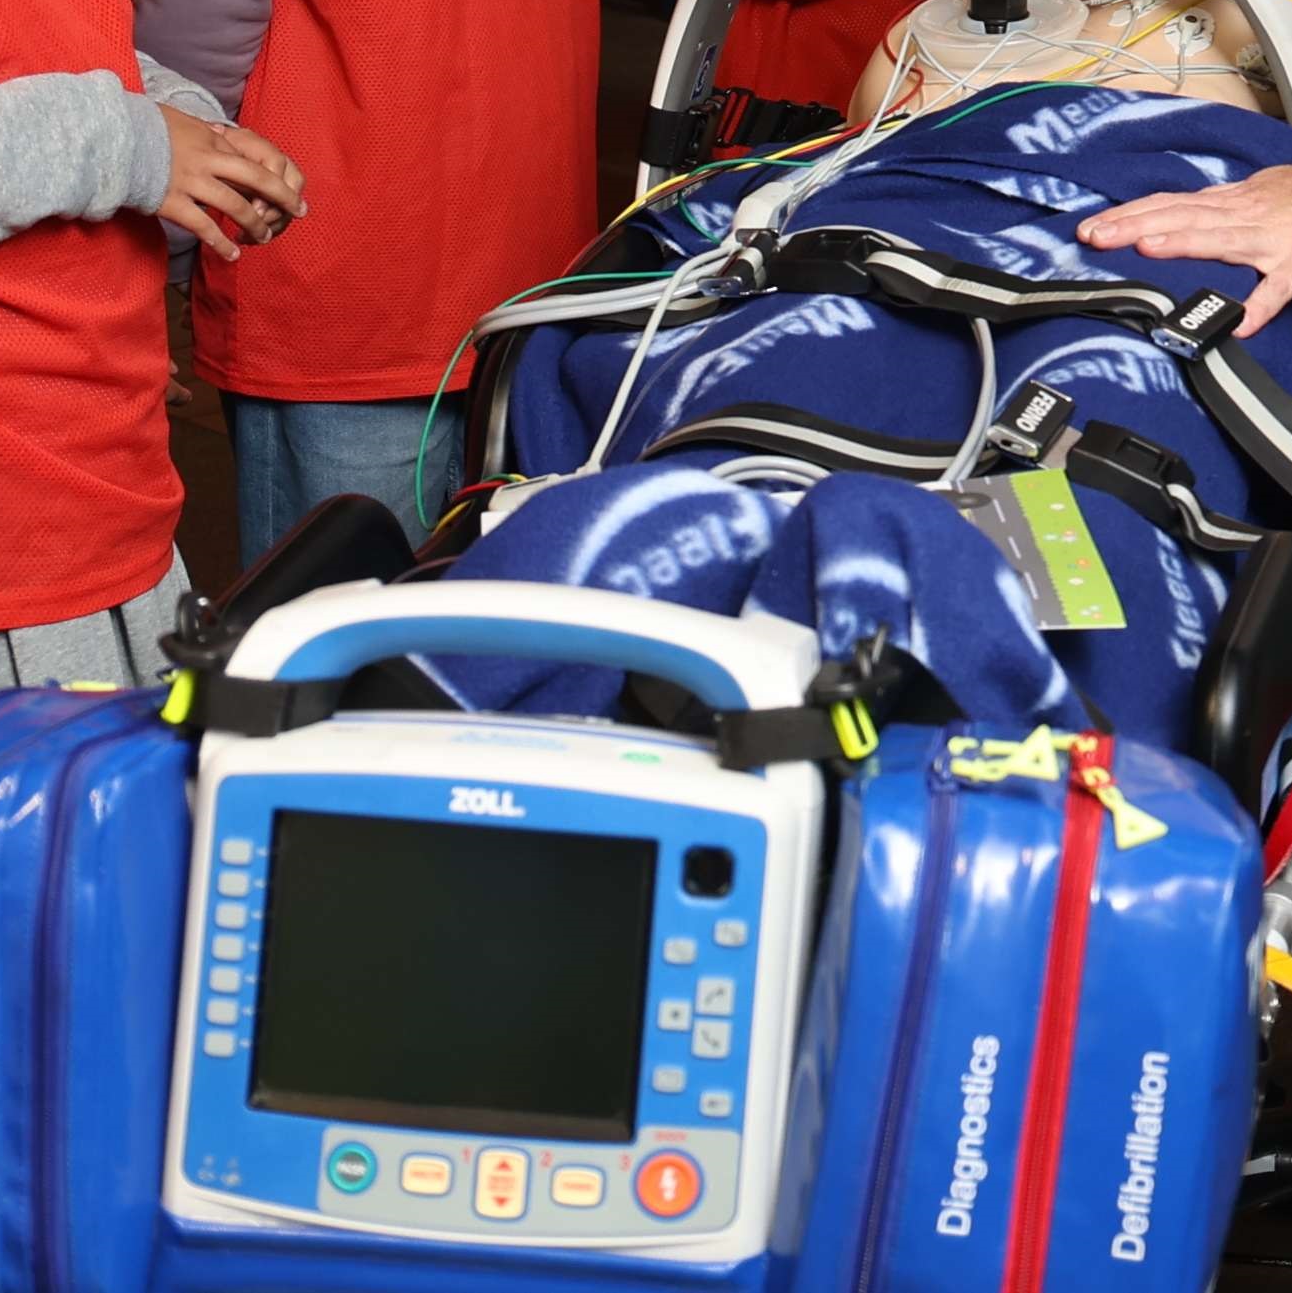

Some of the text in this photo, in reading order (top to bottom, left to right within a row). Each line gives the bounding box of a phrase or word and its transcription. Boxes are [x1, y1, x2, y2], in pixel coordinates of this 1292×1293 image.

[1180, 294, 1226, 331] FERNO
[1016, 390, 1058, 432] FERNO
[448, 786, 525, 818] ZOLL
[936, 1035, 1000, 1237] Diagnostics
[1111, 1051, 1170, 1262] Defibrillation
